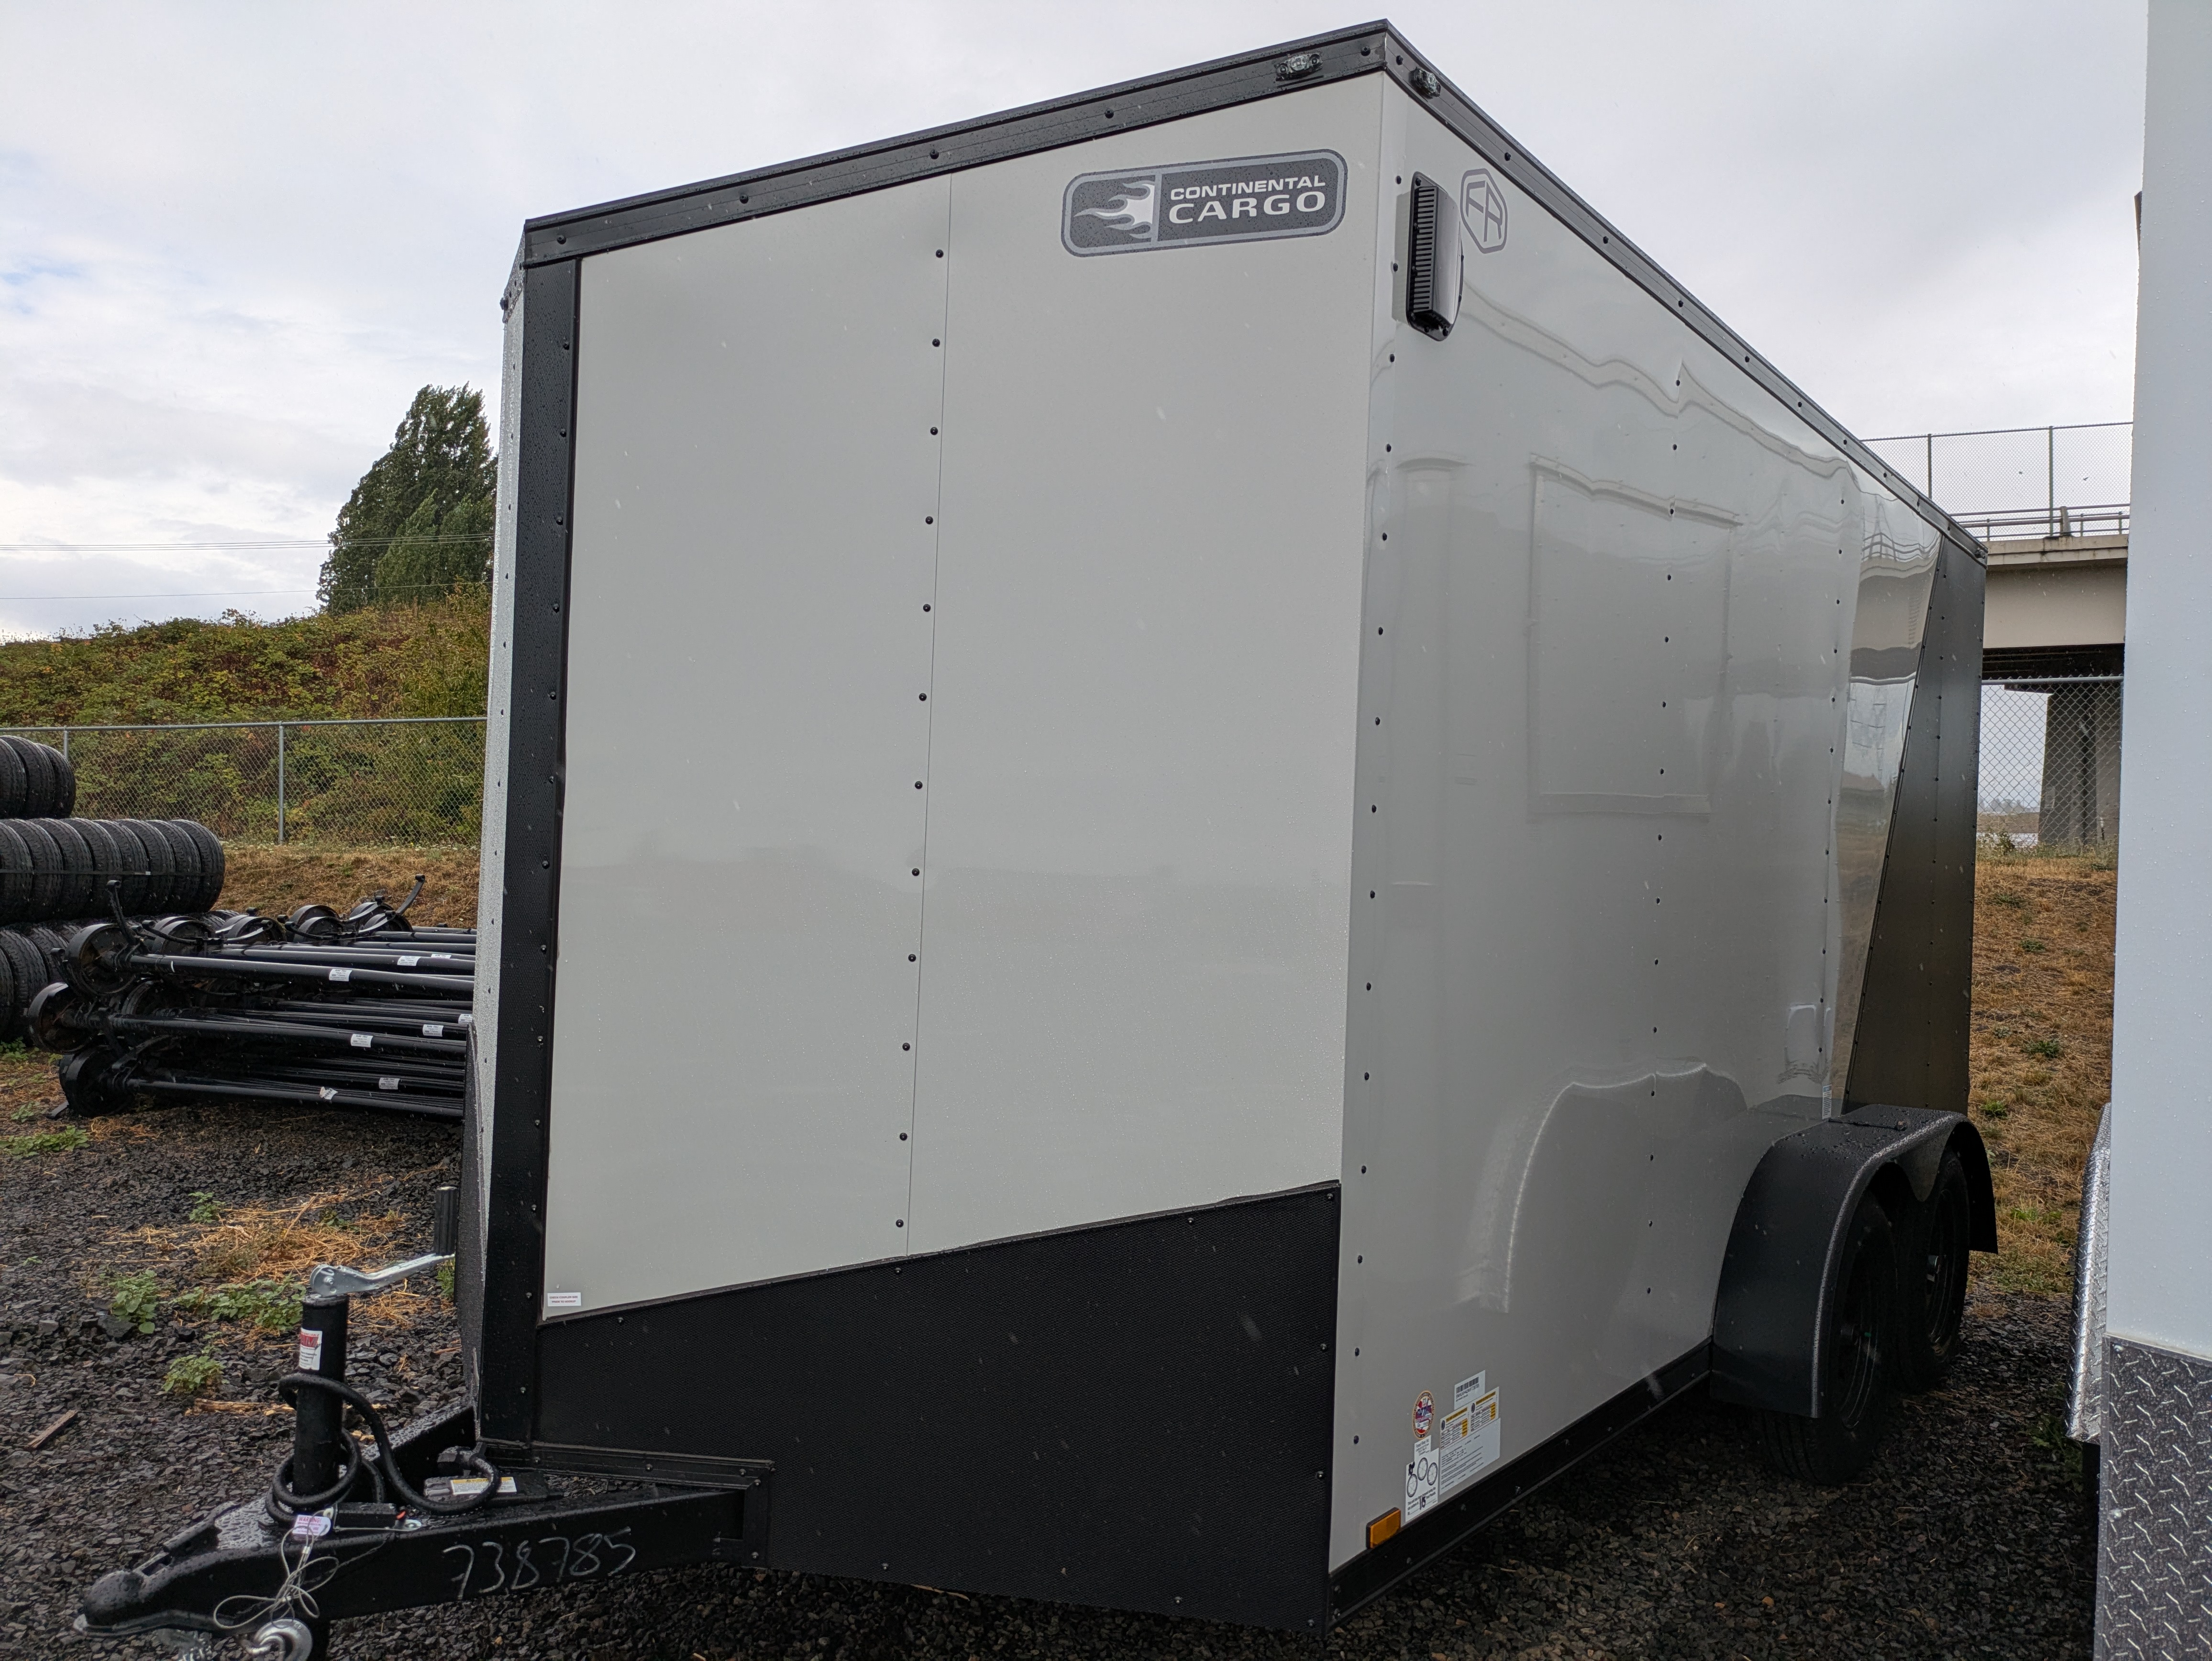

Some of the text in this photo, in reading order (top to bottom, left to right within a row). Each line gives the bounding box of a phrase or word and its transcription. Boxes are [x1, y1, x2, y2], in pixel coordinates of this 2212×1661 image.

[1170, 175, 1326, 200] CONTINENTAL
[1169, 191, 1326, 224] CARGO
[442, 1526, 636, 1600] 738785
